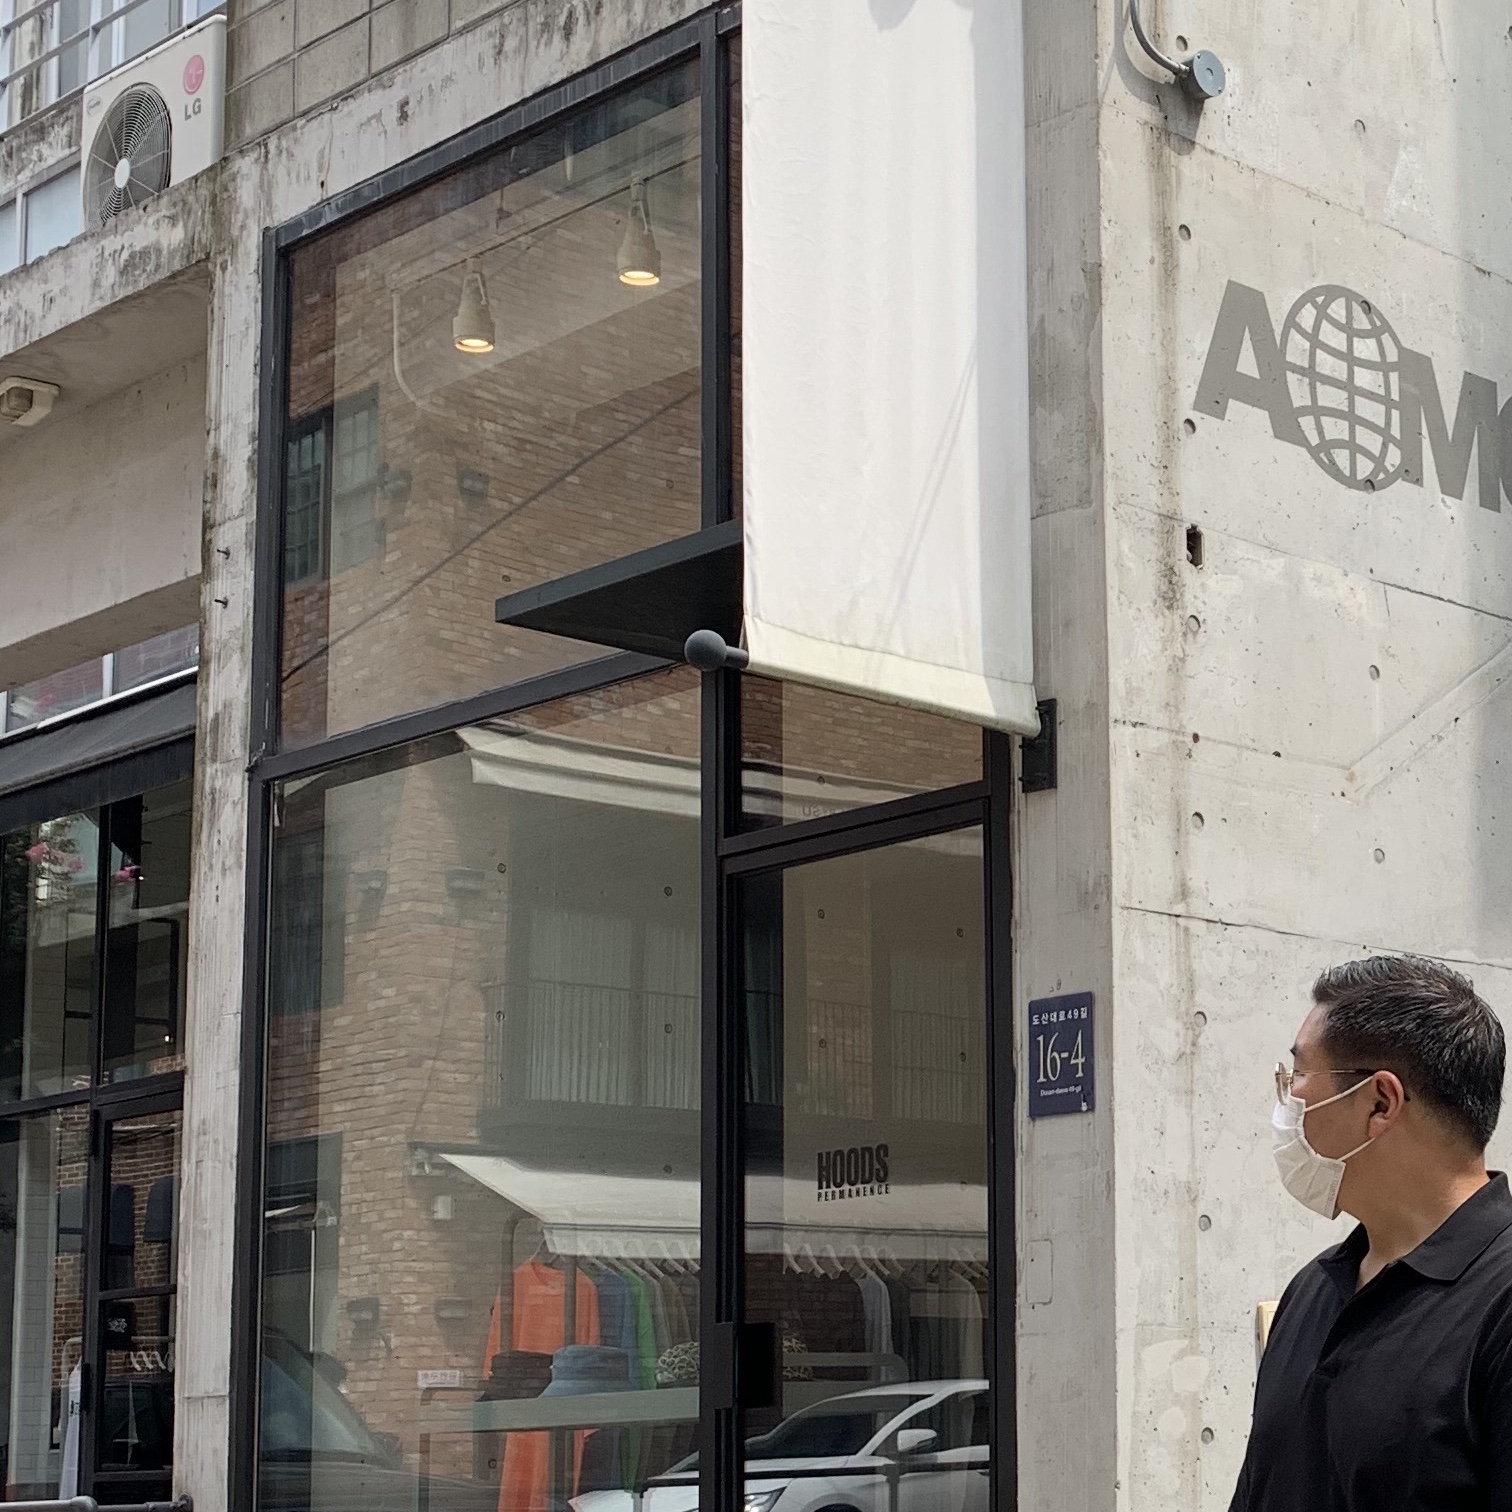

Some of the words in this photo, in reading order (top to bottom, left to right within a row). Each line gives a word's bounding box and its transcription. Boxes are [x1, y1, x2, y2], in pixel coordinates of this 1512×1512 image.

[184, 97, 202, 121] LG
[1032, 1007, 1088, 1025] 도산대로49길
[1036, 1029, 1086, 1083] 16-4
[817, 1143, 889, 1190] HOODS
[817, 1184, 889, 1202] PERMANENCE
